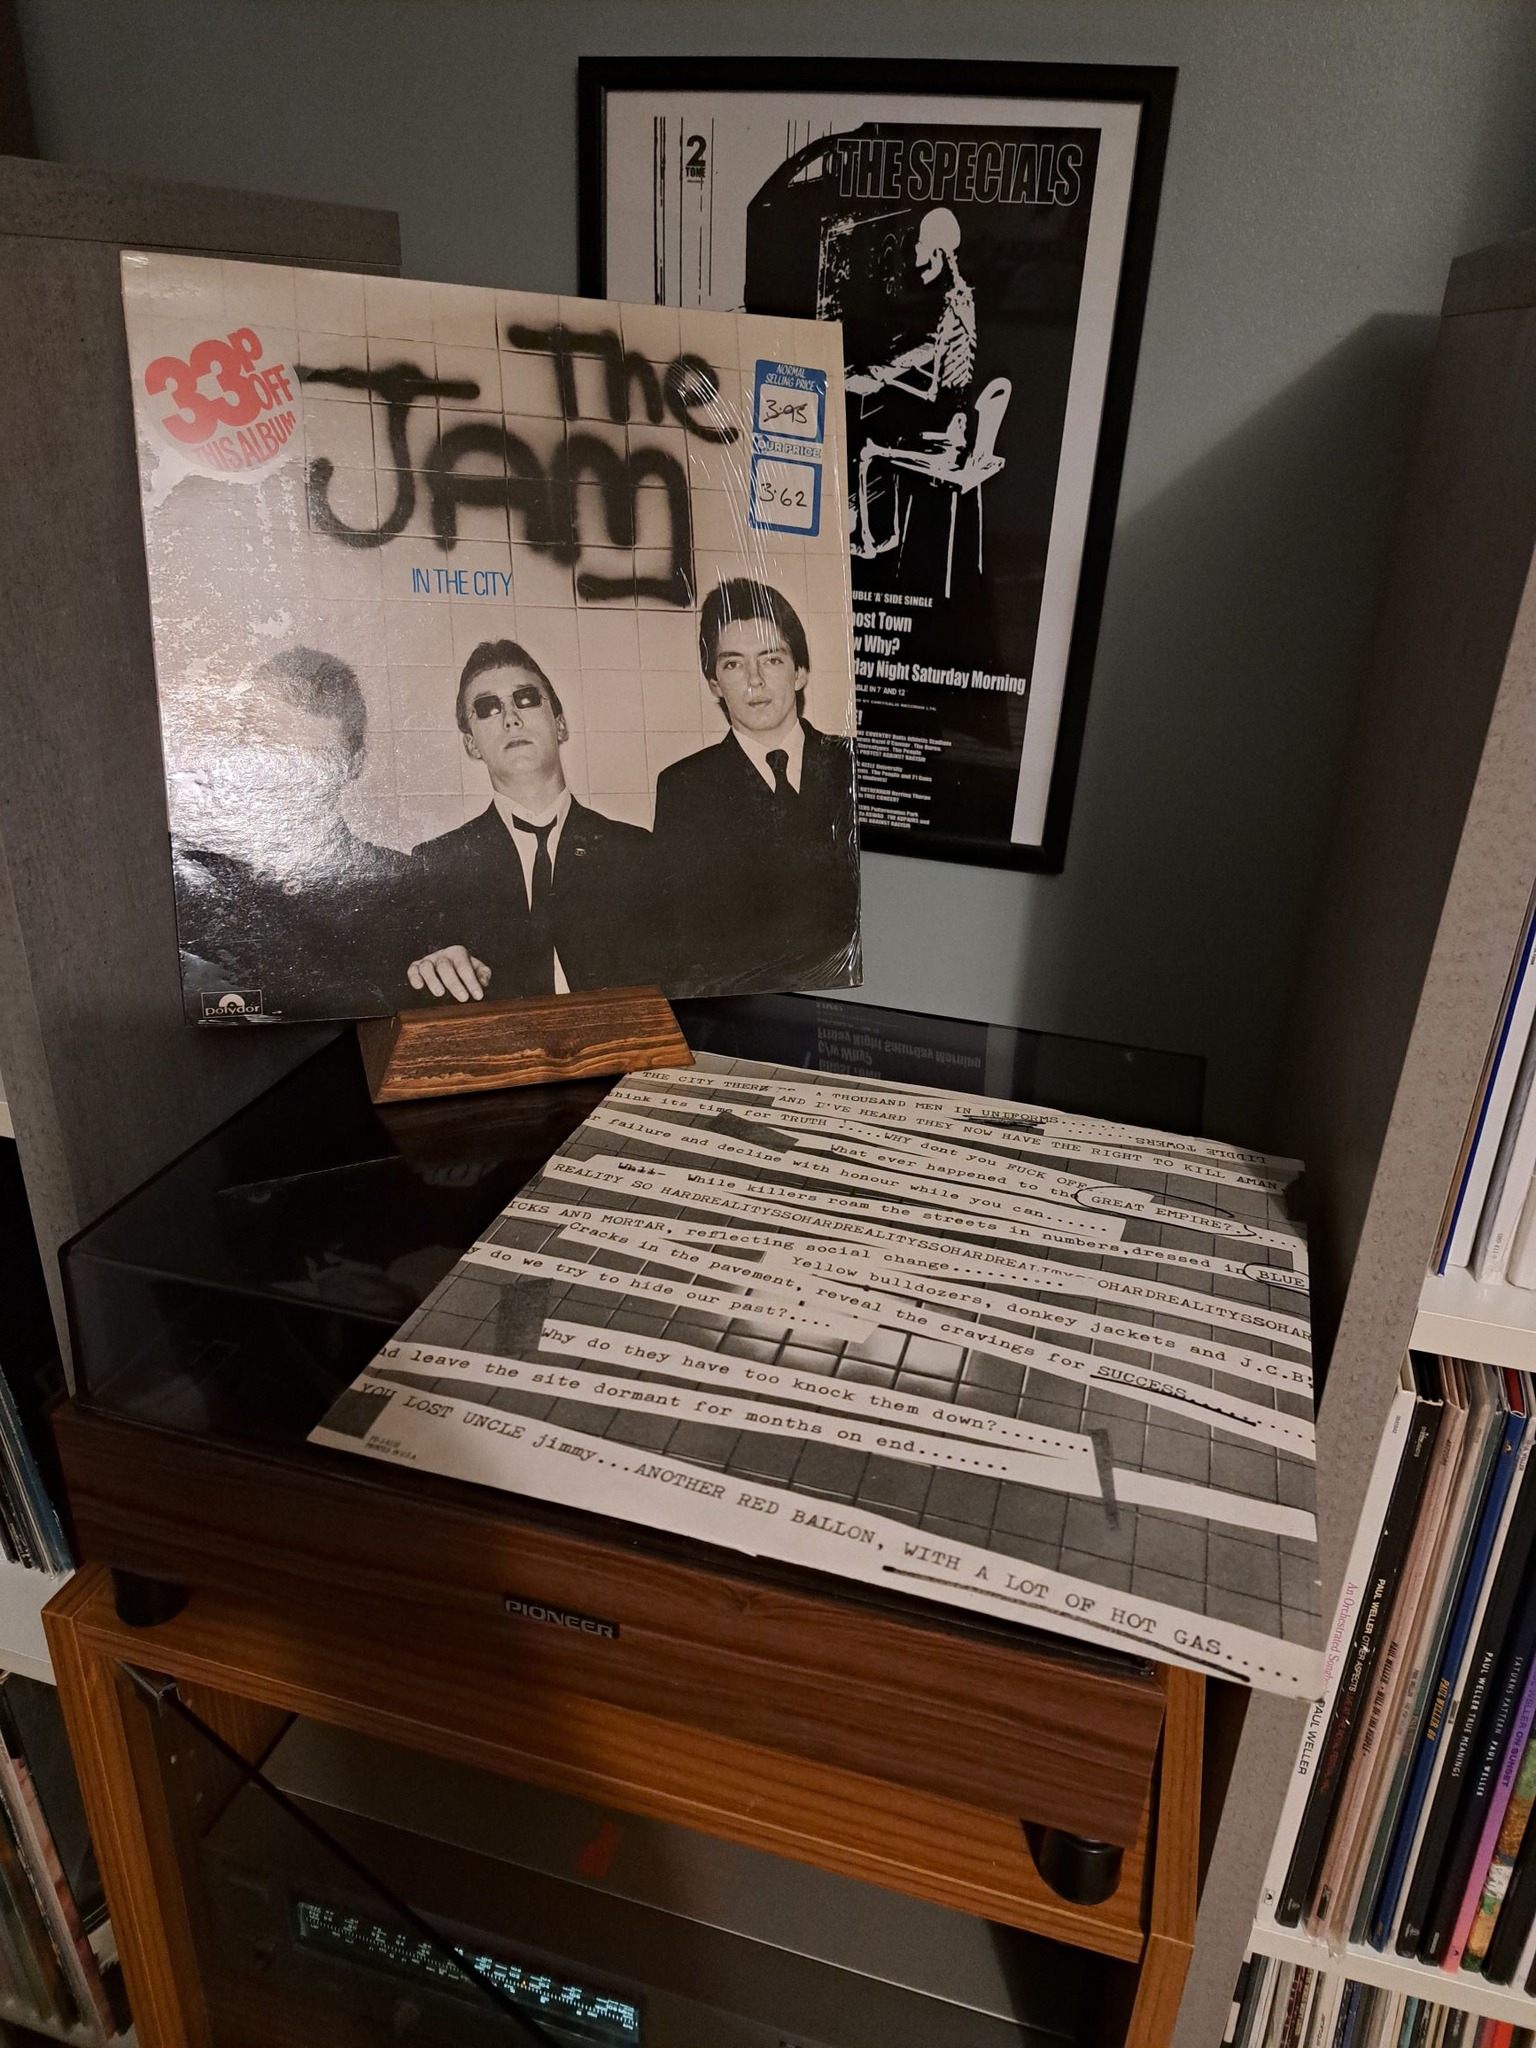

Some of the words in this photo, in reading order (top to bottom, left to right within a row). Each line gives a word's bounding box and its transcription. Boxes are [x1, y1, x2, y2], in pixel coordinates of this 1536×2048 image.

[687, 135, 706, 166] 2
[836, 139, 904, 198] THE
[906, 140, 1083, 206] SPECIALS
[249, 364, 293, 411] OFF
[765, 373, 794, 388] SELLING
[795, 379, 816, 391] PRICE
[777, 364, 806, 379] NORMAL
[236, 411, 296, 467] ALBUM
[784, 442, 822, 458] PRICE
[411, 567, 432, 595] IN
[435, 568, 471, 596] THE
[473, 570, 515, 598] CITY
[853, 590, 872, 602] UBLE
[884, 593, 903, 604] SIDE
[904, 595, 933, 608] SINGLE
[878, 612, 912, 632] Town
[864, 634, 900, 656] Why?
[855, 658, 874, 678] day
[876, 662, 910, 682] Night
[912, 664, 969, 689] Saturday
[972, 670, 1027, 696] Morning
[883, 687, 897, 695] AND
[643, 1071, 670, 1081] THE
[678, 1076, 714, 1085] CITY
[832, 1093, 906, 1107] THOUSAND
[915, 1102, 943, 1111] MEN
[954, 1106, 971, 1114] IN
[661, 1098, 688, 1107] its
[743, 1110, 772, 1119] for
[780, 1114, 828, 1126] TRUTH
[920, 1142, 959, 1156] dont
[965, 1154, 997, 1167] you
[1006, 1163, 1047, 1179] FUCK
[778, 1095, 806, 1105] AND
[859, 1108, 907, 1122] HEARD
[916, 1118, 954, 1130] THEY
[963, 1126, 993, 1136] NOW
[1001, 1133, 1041, 1146] HAVE
[1051, 1141, 1081, 1152] THE
[1091, 1148, 1142, 1162] RIGHT
[1153, 1157, 1175, 1167] TO
[1183, 1163, 1226, 1179] KILL
[554, 1163, 625, 1184] REALITY
[630, 1180, 653, 1191] SO
[608, 1118, 672, 1137] failure
[681, 1135, 709, 1146] and
[716, 1138, 782, 1163] decline
[792, 1158, 831, 1174] with
[840, 1164, 900, 1188] honour
[909, 1183, 960, 1200] while
[969, 1197, 1001, 1208] you
[830, 1144, 872, 1158] What
[877, 1154, 917, 1168] ever
[926, 1163, 1007, 1185] happened
[1019, 1181, 1039, 1191] to
[1090, 1196, 1144, 1212] GREAT
[558, 1207, 592, 1221] AND
[600, 1215, 673, 1235] MORTAR,
[685, 1226, 795, 1251] reflecting
[805, 1243, 871, 1259] social
[687, 1173, 736, 1189] While
[746, 1184, 818, 1202] killers
[828, 1196, 870, 1210] roam
[881, 1203, 911, 1216] the
[922, 1212, 998, 1230] streets
[1009, 1226, 1031, 1237] in
[1258, 1269, 1305, 1288] BLUE
[490, 1250, 512, 1261] do
[523, 1258, 543, 1268] we
[554, 1263, 588, 1279] try
[598, 1272, 620, 1284] to
[629, 1276, 674, 1296] hide
[685, 1289, 721, 1306] our
[569, 1221, 629, 1244] Cracks
[640, 1240, 659, 1253] in
[670, 1249, 700, 1263] the
[707, 1259, 802, 1292] pavement,
[815, 1287, 883, 1313] reveal
[895, 1308, 929, 1326] the
[940, 1322, 1035, 1358] cravings
[1046, 1352, 1086, 1370] for
[791, 1256, 858, 1277] Yellow
[869, 1272, 991, 1309] bulldozers,
[1006, 1303, 1078, 1328] donkey
[1089, 1322, 1177, 1350] jackets
[1189, 1344, 1226, 1362] and
[540, 1326, 577, 1345] Why
[586, 1337, 611, 1351] do
[623, 1343, 670, 1364] they
[681, 1354, 730, 1376] have
[744, 1366, 780, 1386] too
[791, 1377, 856, 1403] knock
[868, 1394, 920, 1416] them
[410, 1350, 471, 1370] leave
[484, 1360, 520, 1380] the
[531, 1372, 581, 1390] site
[593, 1379, 681, 1409] dormant
[693, 1399, 733, 1417] for
[744, 1410, 822, 1435] months
[837, 1428, 863, 1444] on
[402, 1395, 455, 1418] LOST
[462, 1412, 526, 1439] UNCLE
[736, 1493, 779, 1516] RED
[790, 1507, 885, 1552] BALLON,
[902, 1541, 962, 1572] WITH
[974, 1565, 990, 1581] A
[1004, 1573, 1050, 1600] LOT
[1064, 1592, 1096, 1614] OF
[1110, 1606, 1158, 1635] HOT
[1345, 1581, 1360, 1597] An
[1373, 1578, 1387, 1601] PAUL
[505, 1600, 613, 1639] PIONEER
[1330, 1596, 1356, 1653] Orchestrated
[1363, 1600, 1380, 1635] WELLER
[1387, 1640, 1399, 1658] PAUL
[1480, 1651, 1494, 1675] PAUL
[1348, 1660, 1364, 1693] ASPECTS
[1379, 1658, 1395, 1685] WELLER
[1437, 1677, 1451, 1698] PAUL
[1505, 1655, 1524, 1695] SATURNS
[1470, 1676, 1487, 1711] WELLER
[1310, 1700, 1326, 1729] PAUL
[1429, 1697, 1446, 1729] WELLER
[1463, 1712, 1477, 1734] TRUE
[1494, 1696, 1512, 1735] PATTERN
[1297, 1730, 1318, 1775] WELLER
[1451, 1735, 1470, 1778] MEANINGS
[1485, 1739, 1499, 1762] PAUL
[1512, 1730, 1524, 1748] ON
[1476, 1764, 1492, 1797] WELLER
[1500, 1746, 1519, 1788] SUNSET
